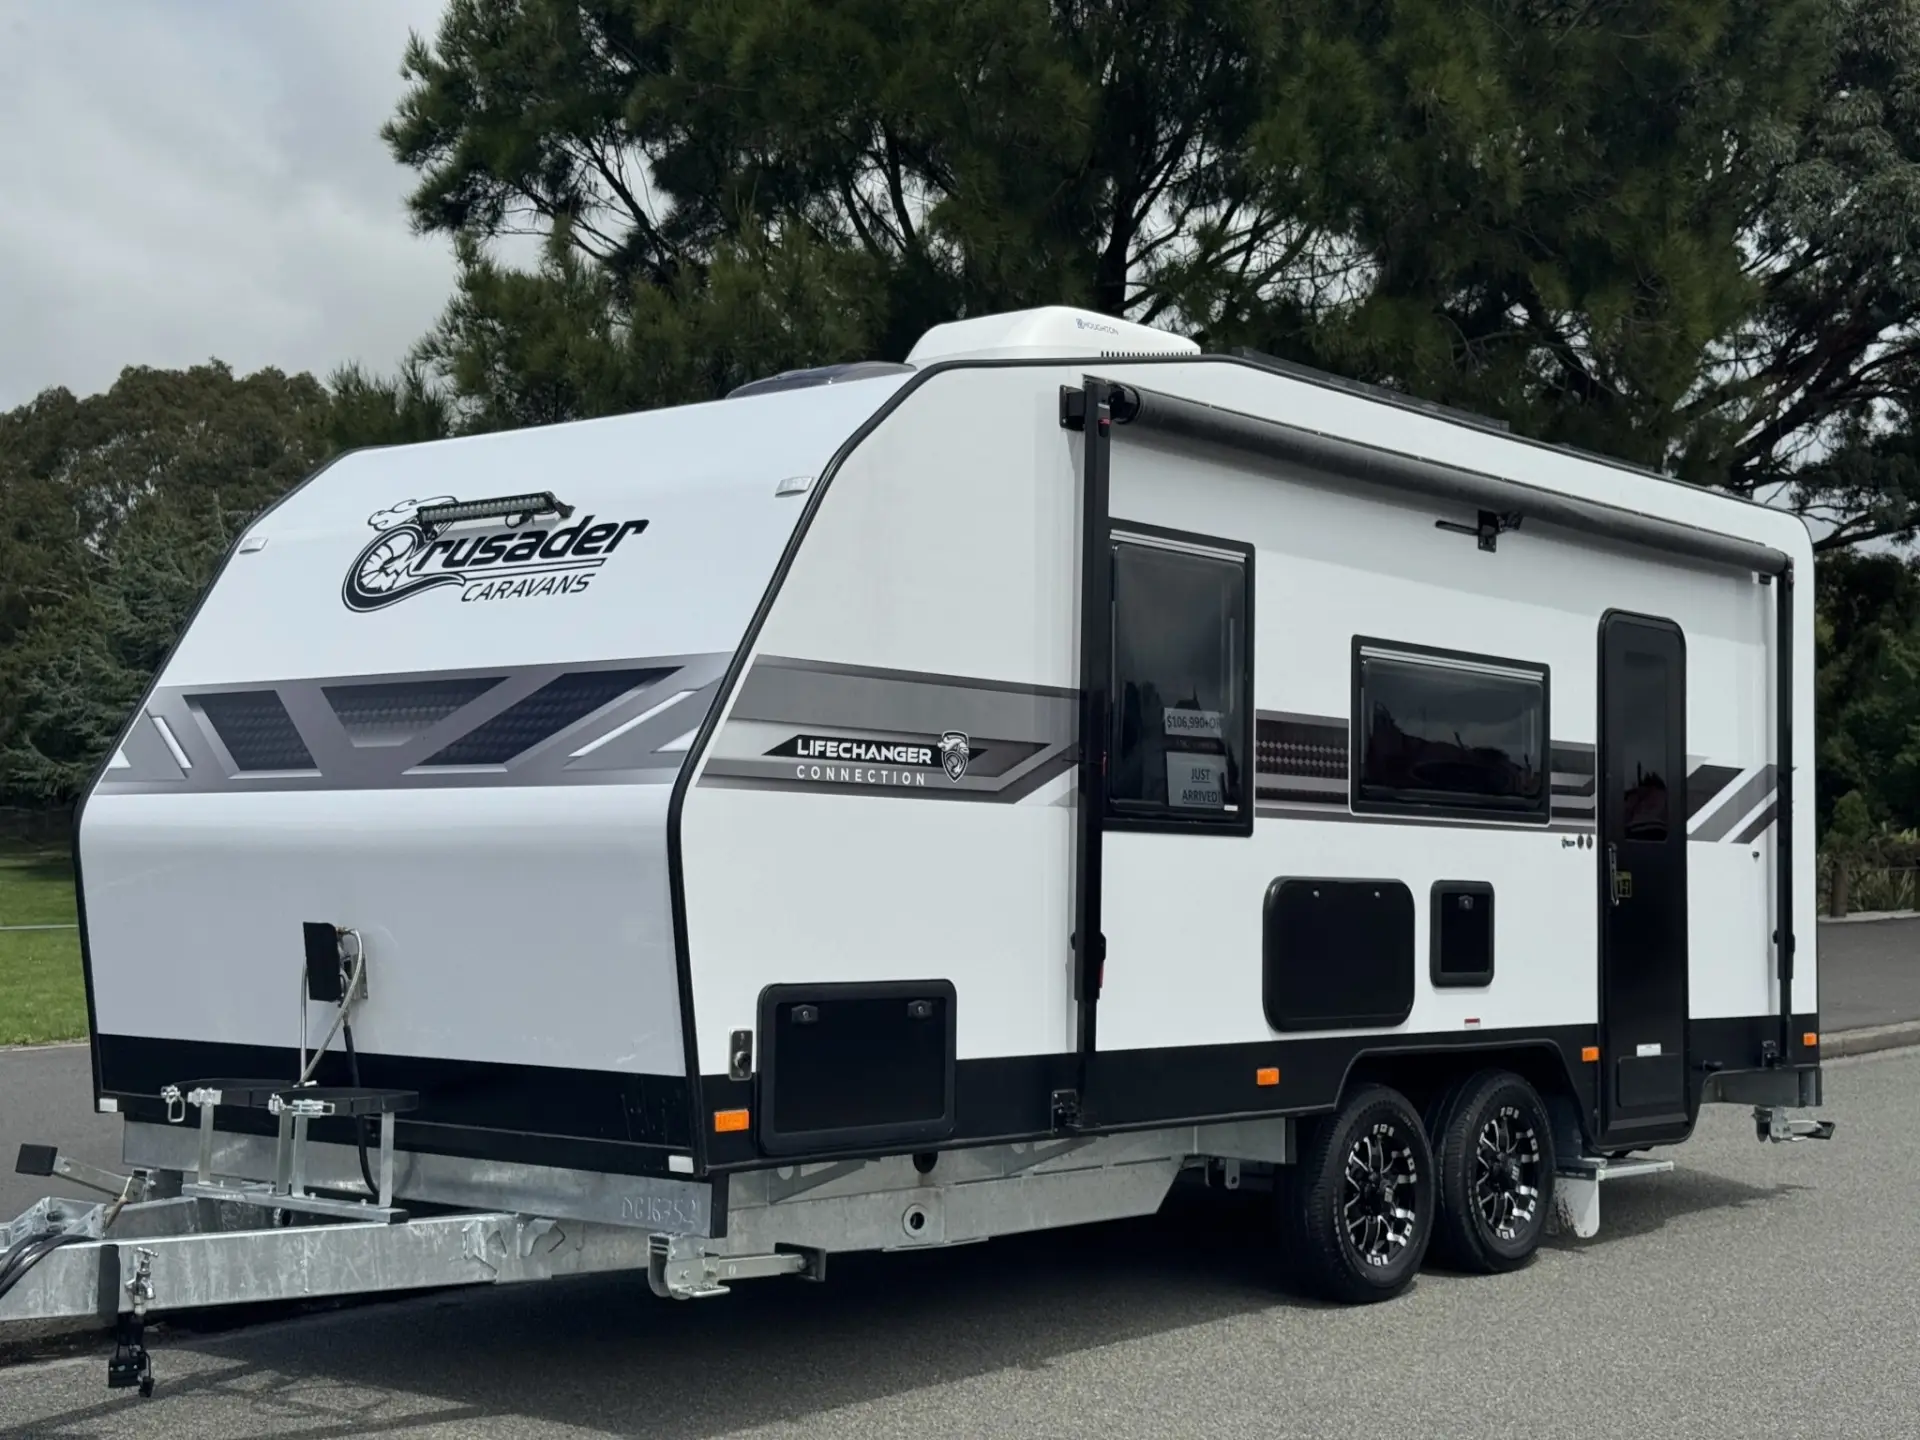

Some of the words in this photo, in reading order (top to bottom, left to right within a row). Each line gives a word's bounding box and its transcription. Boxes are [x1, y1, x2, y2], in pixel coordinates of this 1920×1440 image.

[461, 573, 596, 603] CARAVANS
[796, 738, 932, 764] LIFECHANGER
[796, 765, 925, 786] CONNECTION
[1190, 768, 1211, 781] JUST
